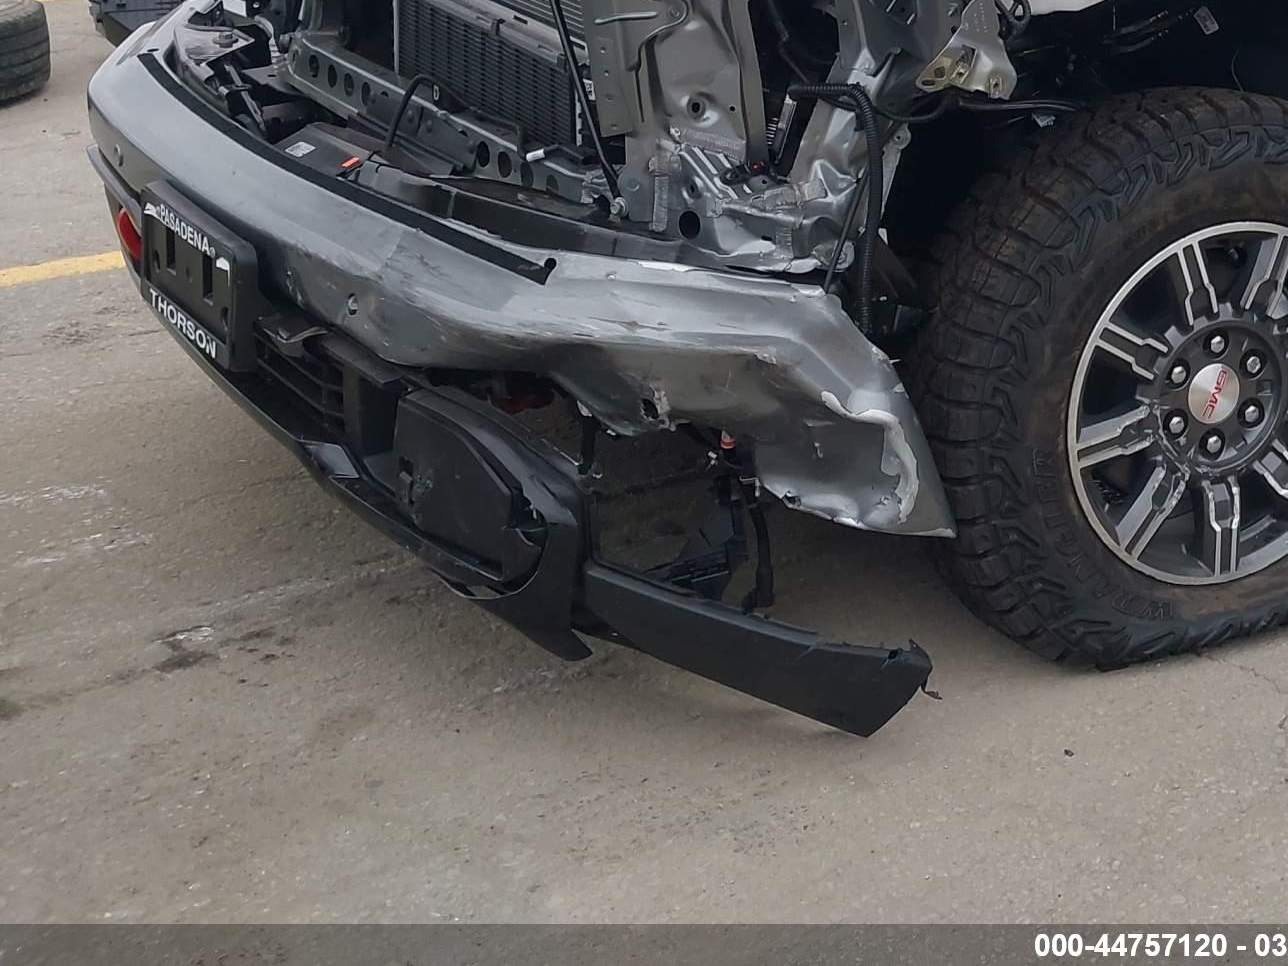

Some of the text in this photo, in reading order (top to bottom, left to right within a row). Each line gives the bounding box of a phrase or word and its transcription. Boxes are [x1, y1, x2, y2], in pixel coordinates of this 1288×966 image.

[160, 203, 210, 255] PASADENA
[149, 290, 217, 359] THORSON
[1202, 369, 1229, 419] GMC
